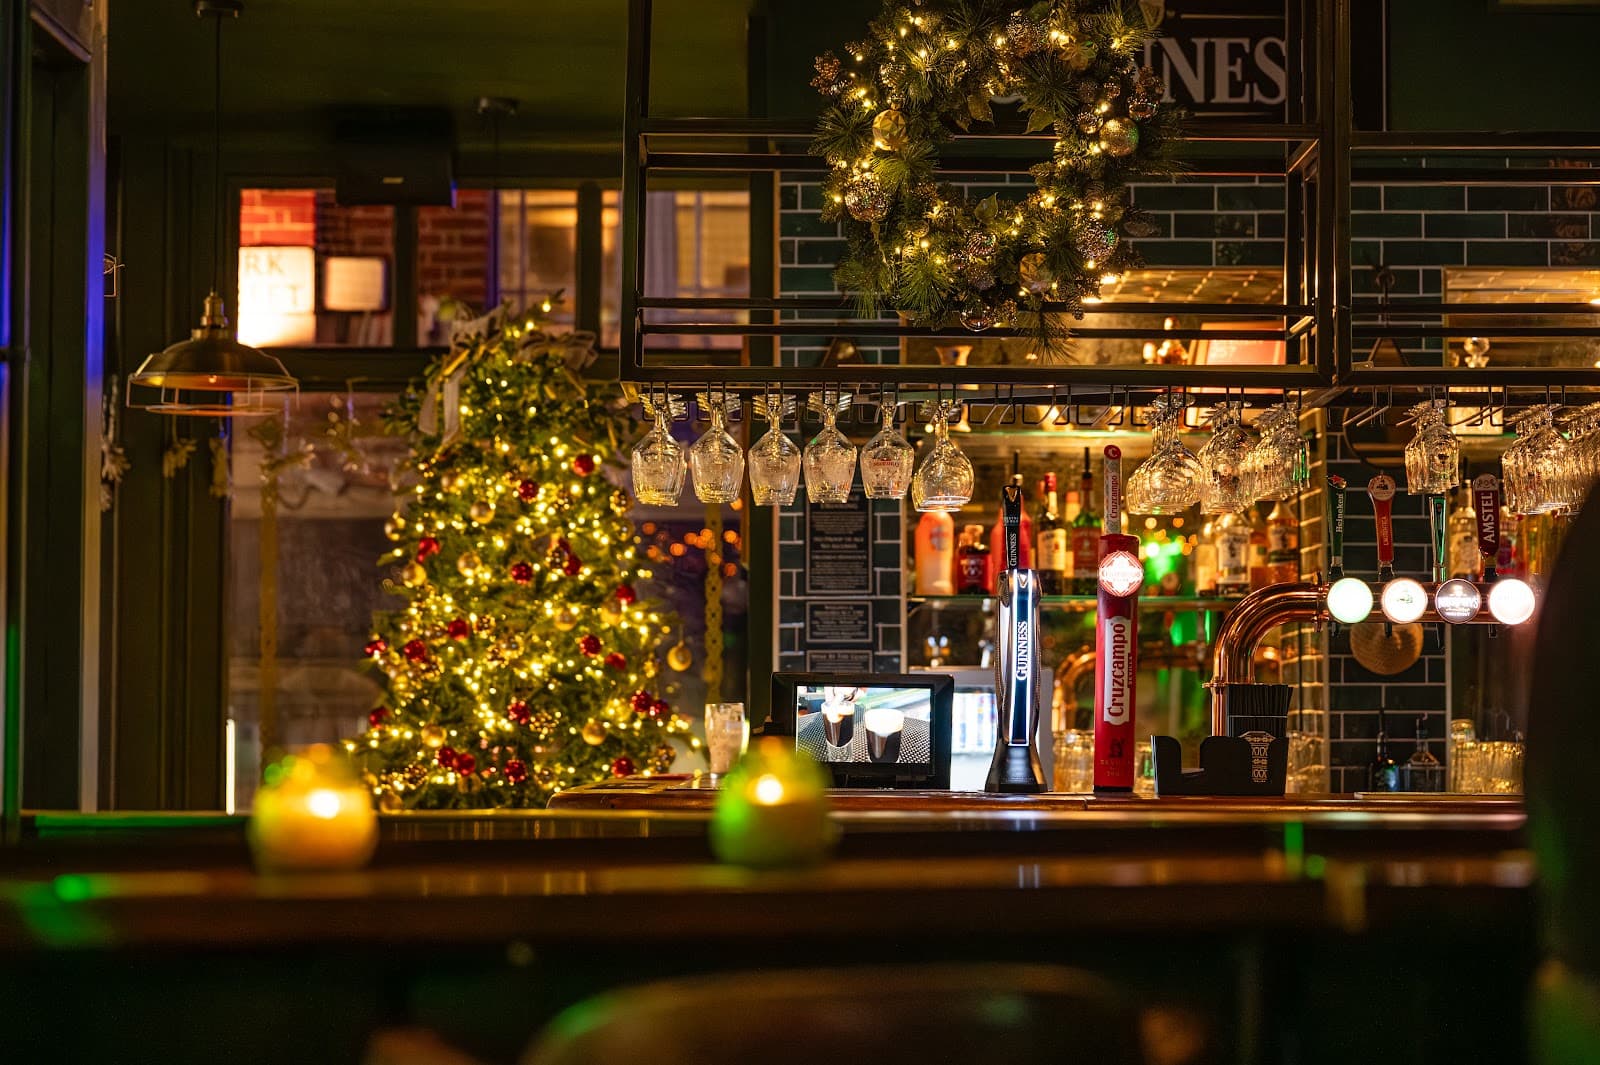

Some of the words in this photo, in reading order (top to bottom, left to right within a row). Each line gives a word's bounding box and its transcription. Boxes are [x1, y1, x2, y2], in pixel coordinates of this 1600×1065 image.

[1110, 475, 1119, 519] Cruzcampo
[1335, 493, 1344, 533] Heineken
[1481, 492, 1496, 543] AMSTEL
[1016, 621, 1028, 681] GUINNESS
[1108, 623, 1128, 717] Cruzcampo
